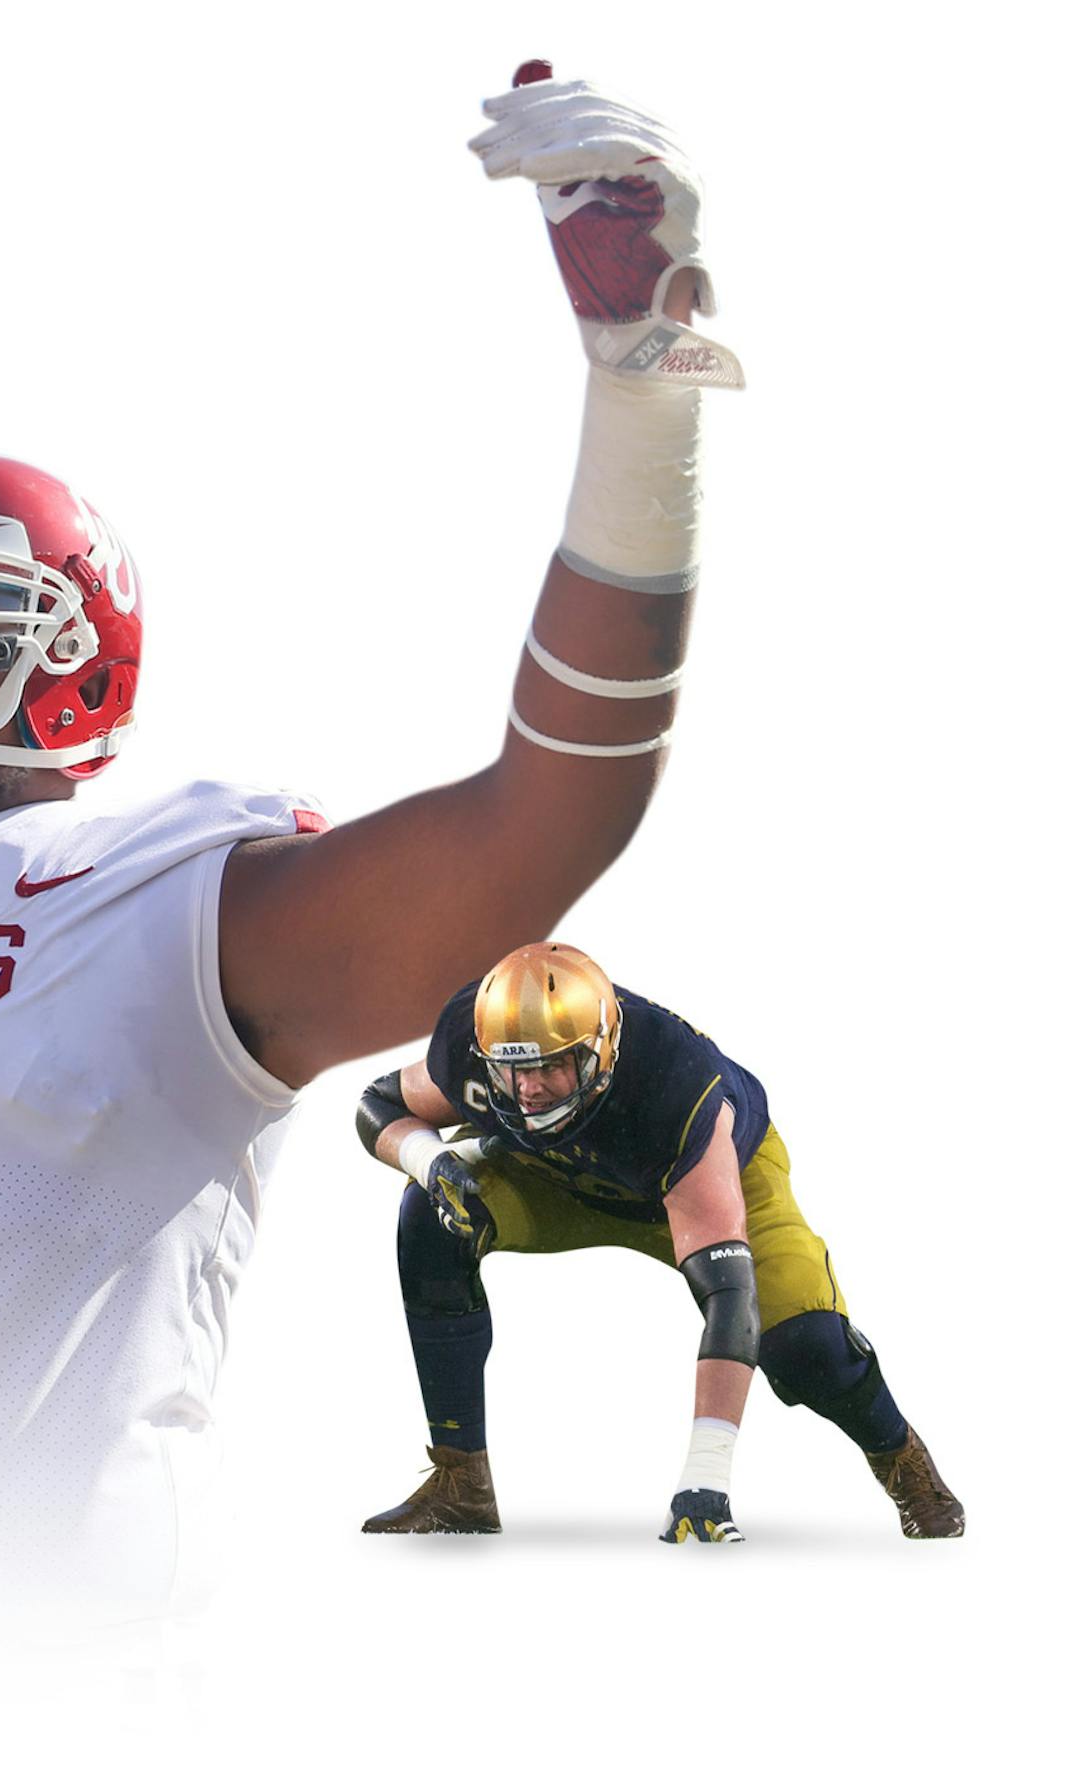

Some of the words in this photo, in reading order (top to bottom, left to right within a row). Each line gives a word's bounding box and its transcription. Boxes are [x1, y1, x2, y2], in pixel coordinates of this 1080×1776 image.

[635, 338, 664, 366] 3XL
[502, 1046, 527, 1056] ARA
[717, 1247, 752, 1260] Muel
